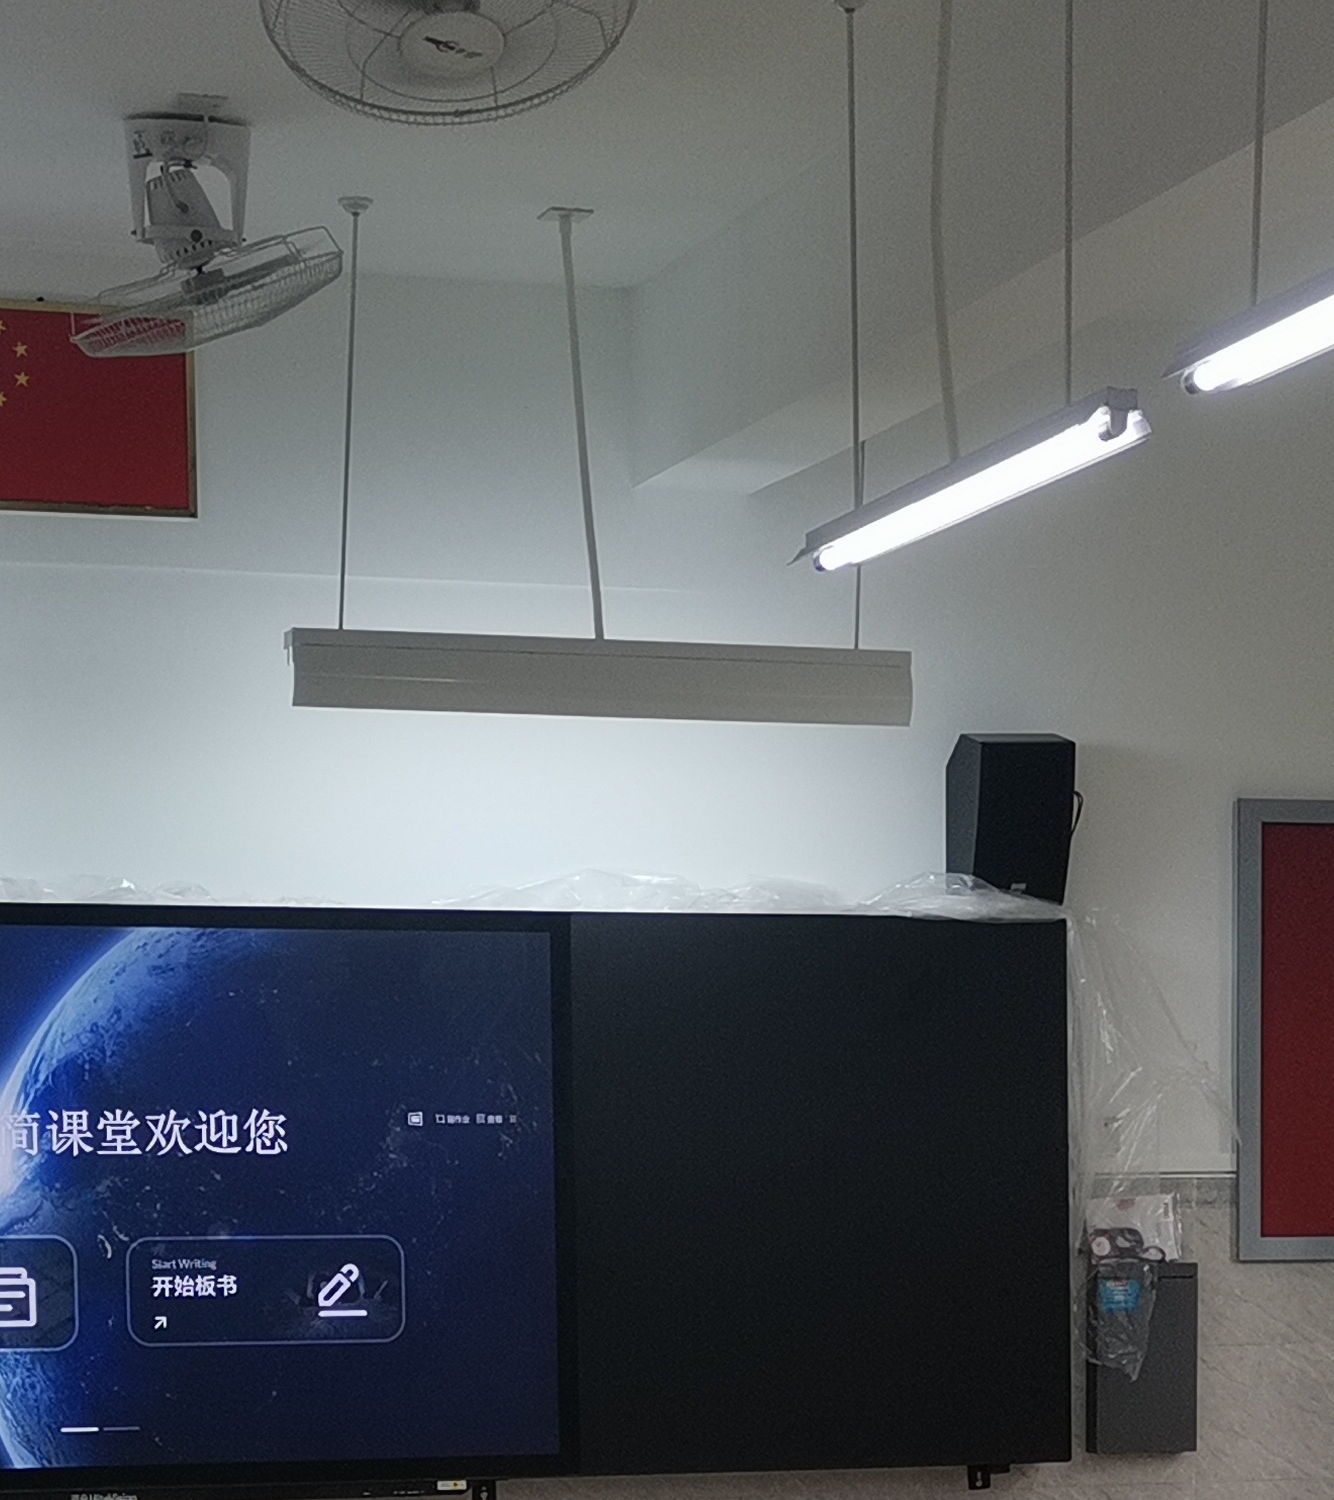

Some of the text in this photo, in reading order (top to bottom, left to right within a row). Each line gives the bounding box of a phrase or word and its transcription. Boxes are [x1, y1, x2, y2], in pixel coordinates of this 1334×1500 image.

[151, 1259, 217, 1271] Start Writing
[151, 1274, 238, 1297] 开始板书
